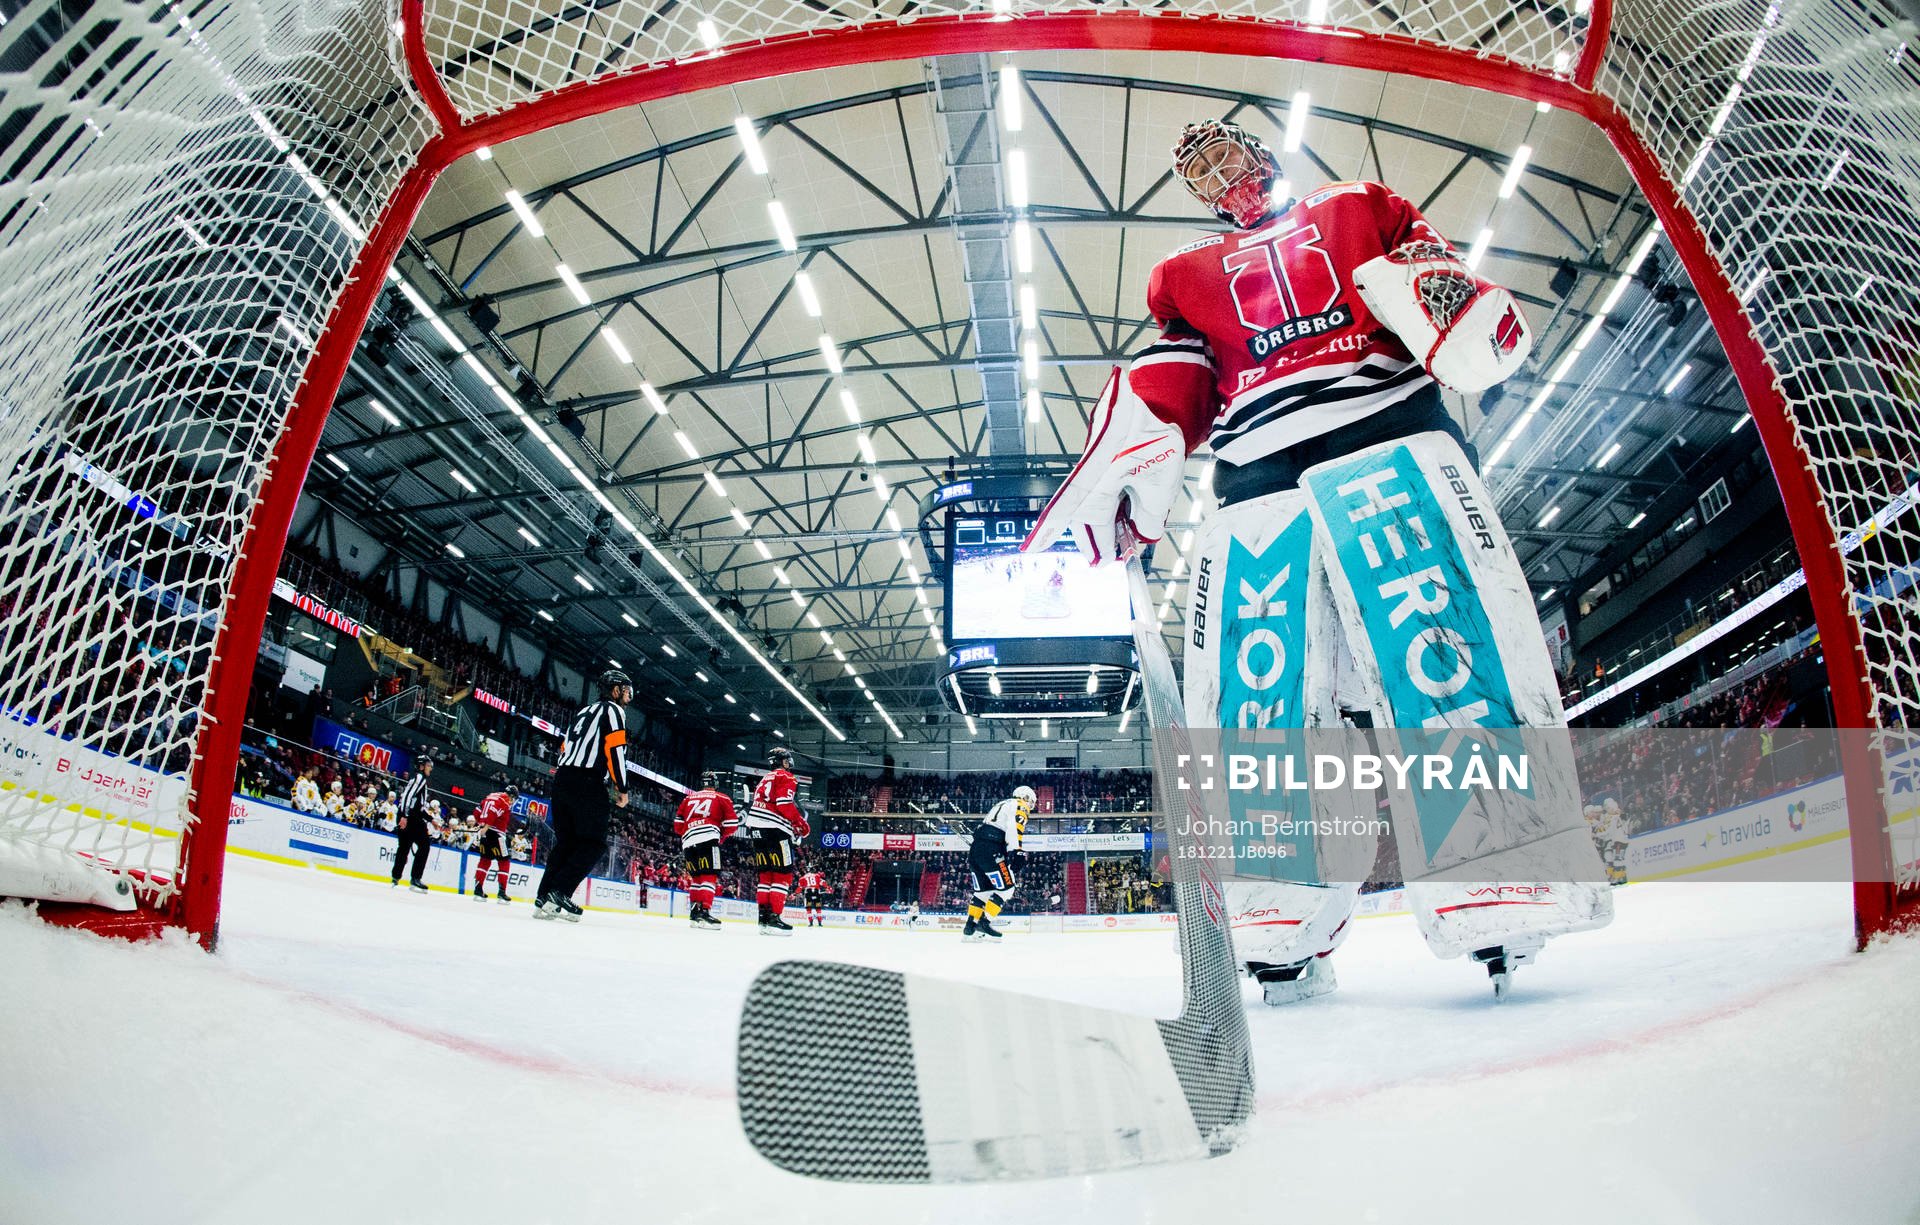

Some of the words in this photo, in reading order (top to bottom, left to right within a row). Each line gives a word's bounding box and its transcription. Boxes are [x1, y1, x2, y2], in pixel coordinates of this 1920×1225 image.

[1254, 310, 1345, 356] ÖREBRO
[1130, 448, 1176, 476] VAPOR
[573, 717, 586, 735] 4
[335, 732, 392, 773] ELON
[511, 797, 549, 822] ELON
[687, 799, 712, 821] 74
[291, 819, 351, 844] MOELVEN
[1720, 815, 1771, 846] bravida
[1644, 839, 1686, 858] PISCATOR
[1466, 886, 1554, 897] VAPOR
[855, 915, 882, 925] ELON
[1231, 908, 1280, 921] APOR
